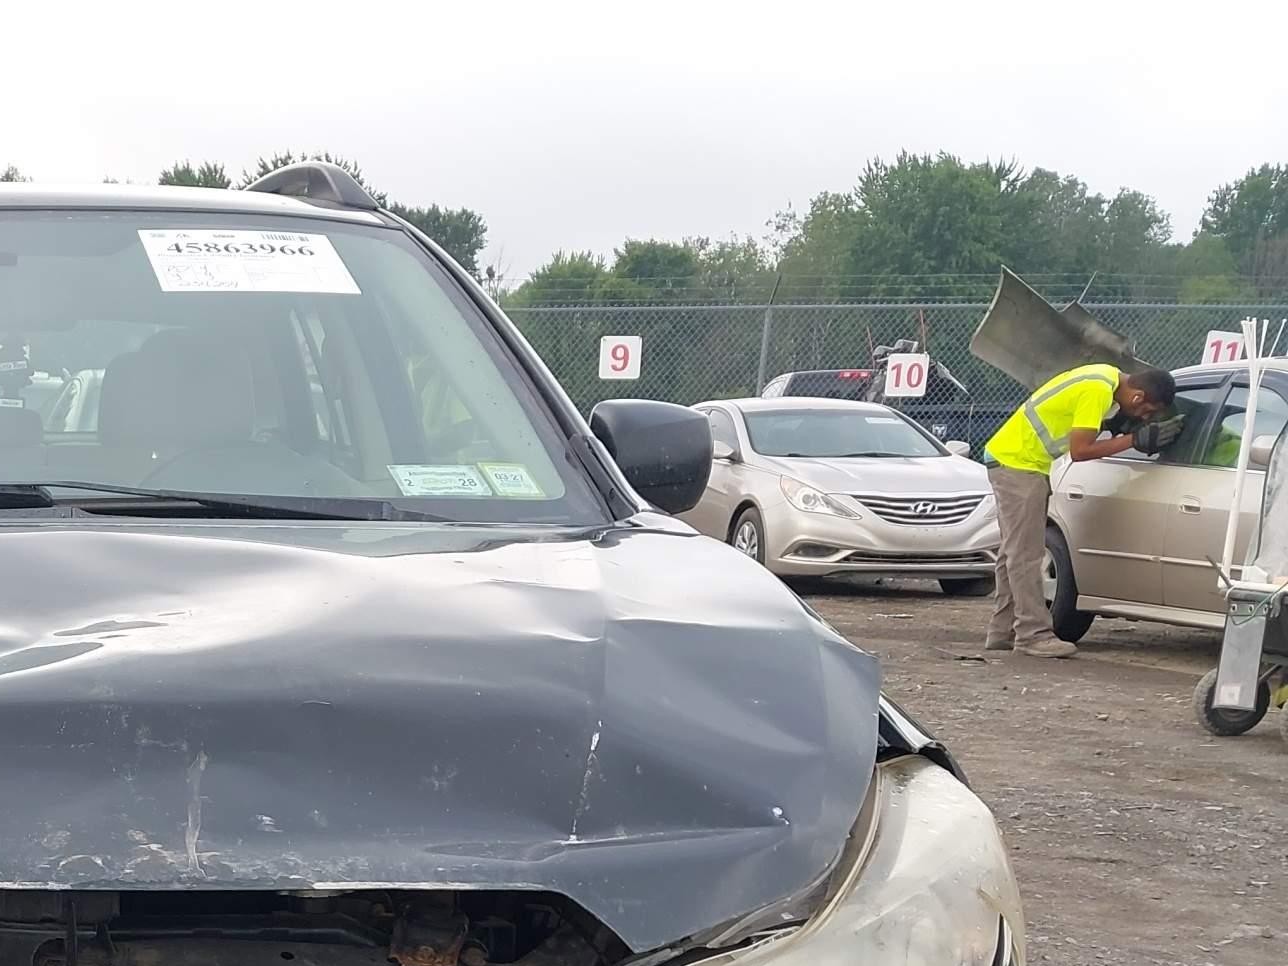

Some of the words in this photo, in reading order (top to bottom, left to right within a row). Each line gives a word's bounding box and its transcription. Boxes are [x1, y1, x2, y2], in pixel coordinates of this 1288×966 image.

[167, 242, 315, 257] 45863966
[611, 345, 630, 372] 9
[1210, 339, 1239, 363] 11
[891, 363, 924, 389] 10
[458, 478, 477, 487] 28
